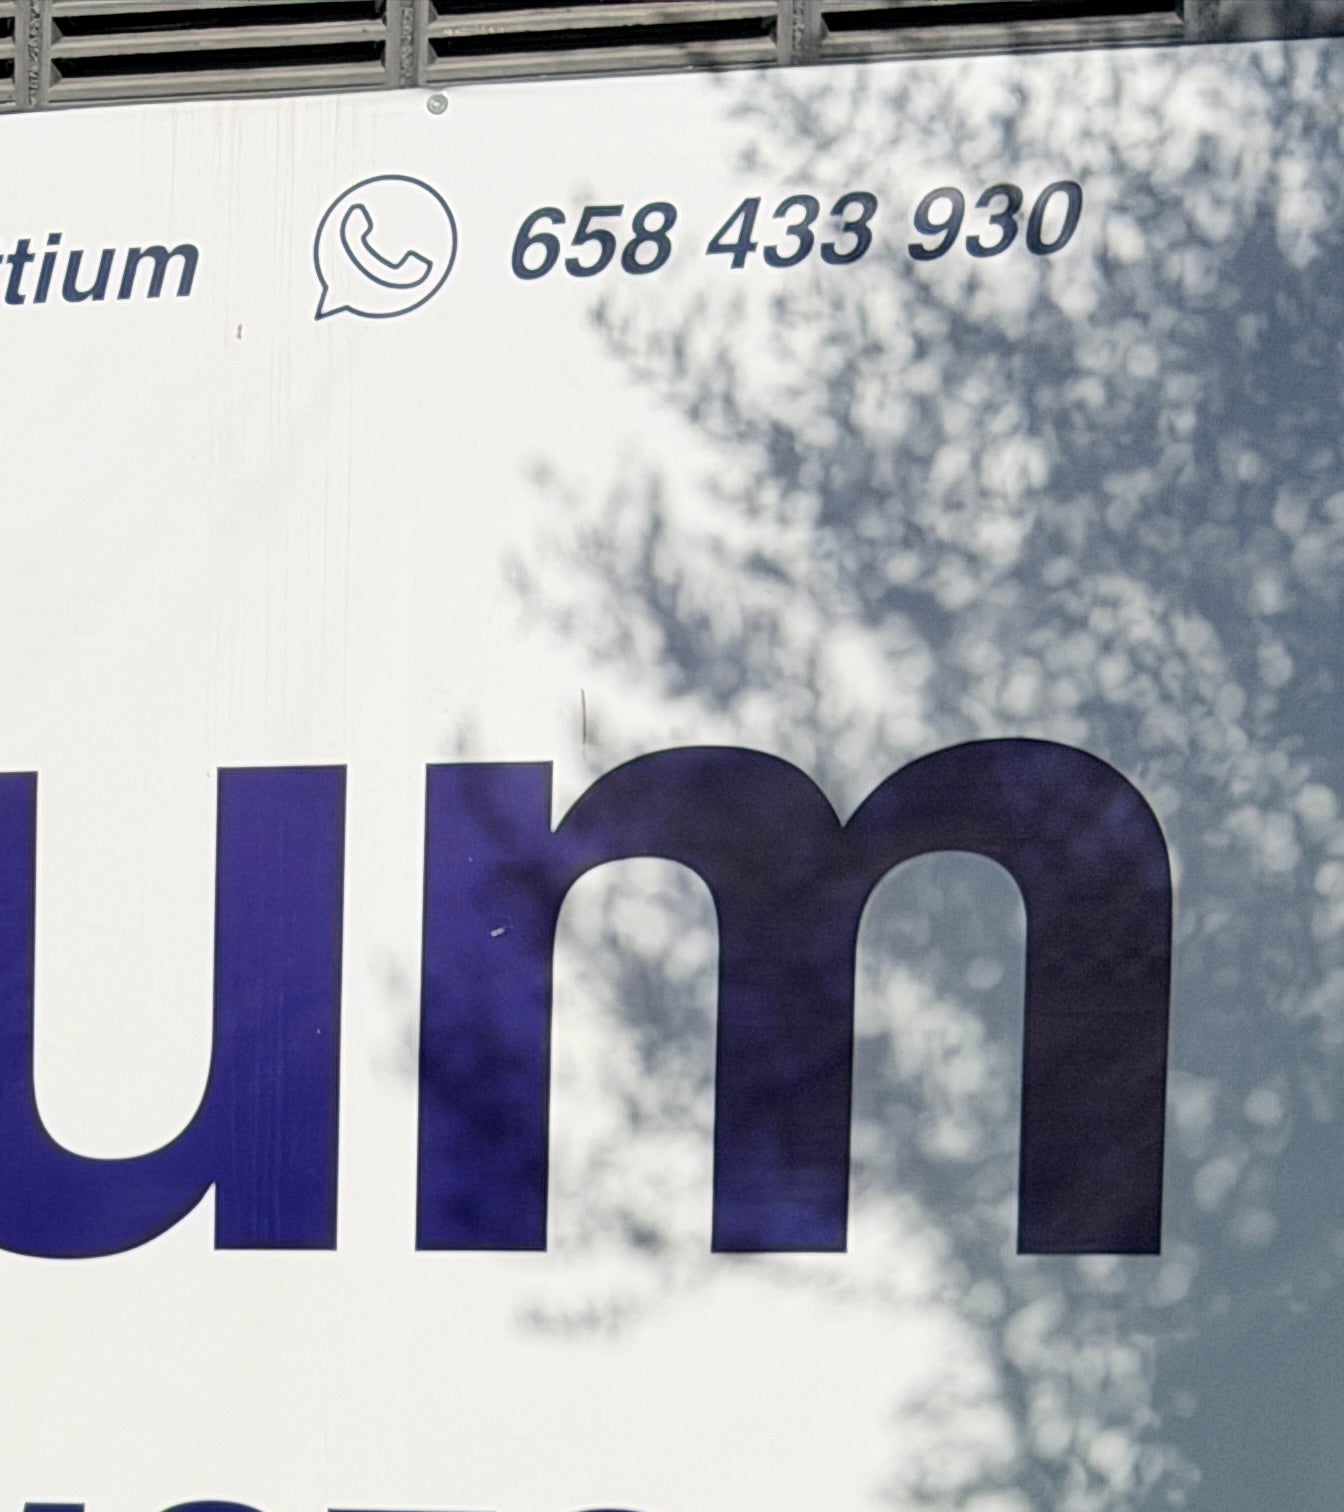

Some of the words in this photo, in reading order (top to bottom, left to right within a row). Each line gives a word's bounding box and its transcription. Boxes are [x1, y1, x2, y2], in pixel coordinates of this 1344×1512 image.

[511, 202, 677, 279] 658
[707, 192, 878, 268] 433
[906, 181, 1084, 263] 930
